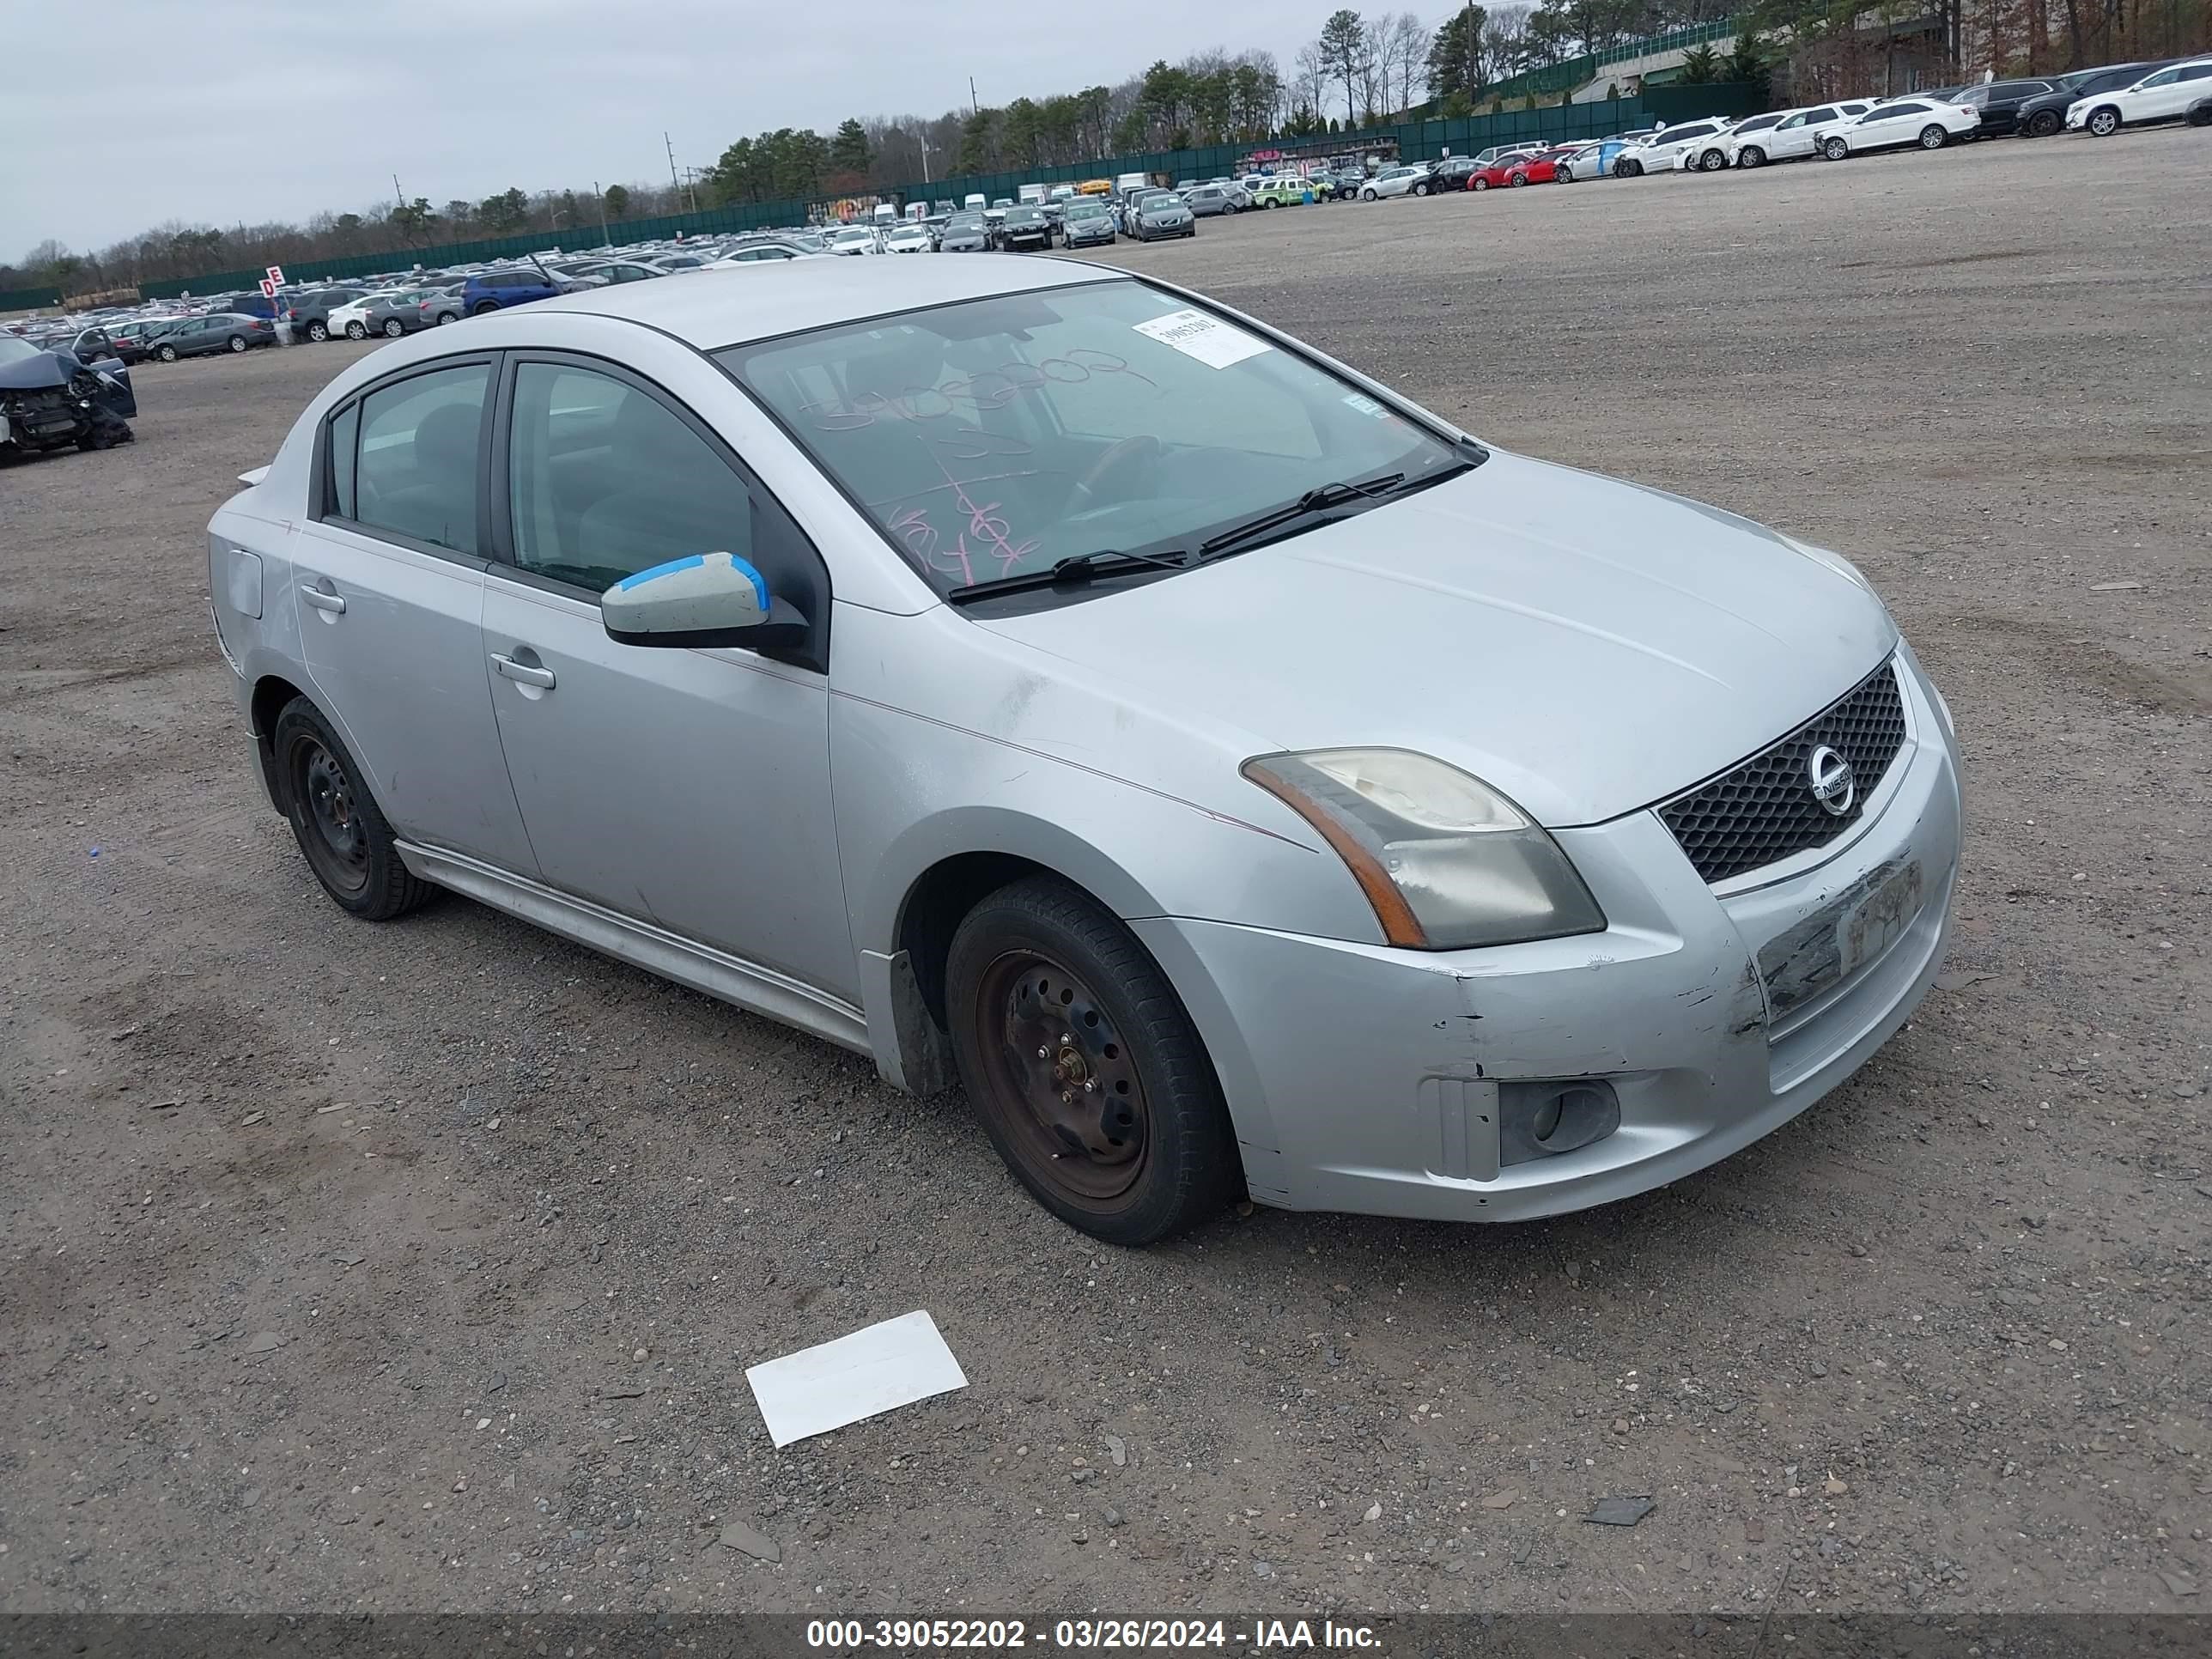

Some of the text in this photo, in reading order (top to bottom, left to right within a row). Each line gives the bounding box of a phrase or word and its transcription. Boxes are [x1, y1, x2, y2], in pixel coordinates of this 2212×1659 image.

[270, 269, 282, 283] E
[262, 281, 274, 295] D
[1159, 319, 1216, 342] 39052202
